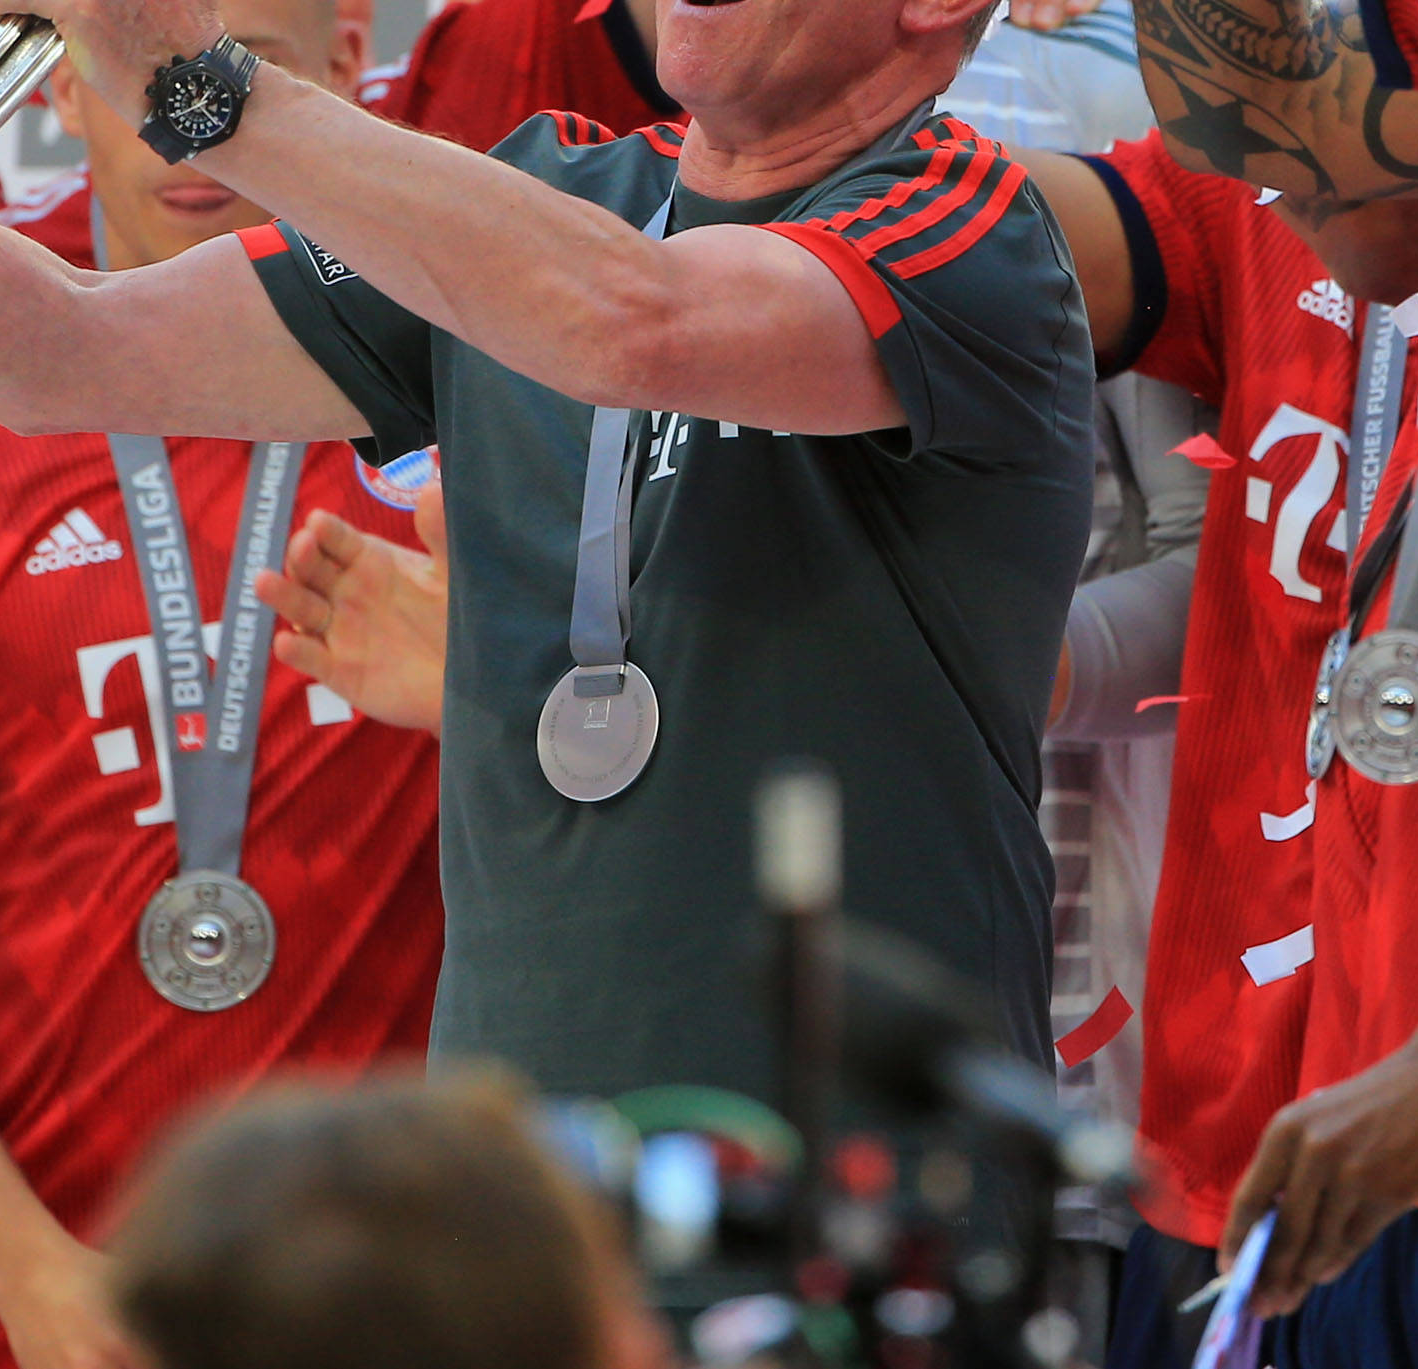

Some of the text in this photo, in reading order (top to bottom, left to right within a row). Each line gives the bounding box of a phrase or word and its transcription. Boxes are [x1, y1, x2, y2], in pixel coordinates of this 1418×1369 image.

[25, 537, 124, 576] adidas
[131, 462, 204, 707] BUNDESLIGA
[217, 612, 259, 753] DEUTSCHER
